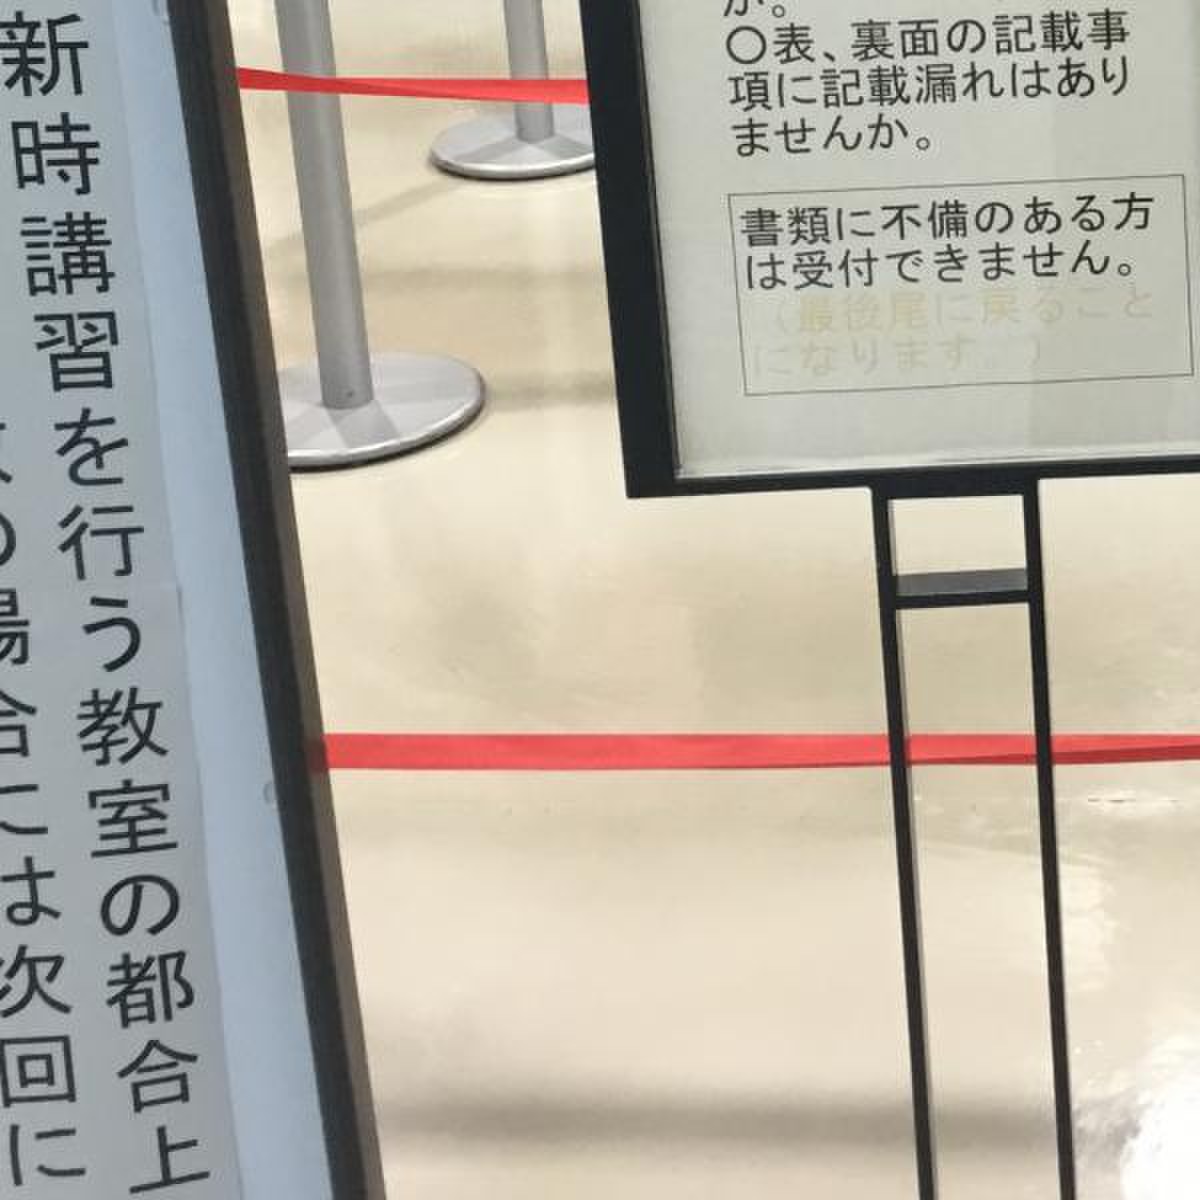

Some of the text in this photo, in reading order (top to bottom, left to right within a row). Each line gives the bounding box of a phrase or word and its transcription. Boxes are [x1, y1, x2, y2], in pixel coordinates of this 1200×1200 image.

[728, 56, 1130, 113] 項に記載漏れはあり
[733, 114, 932, 158] ませんか。
[739, 190, 1155, 248] 書類に不備のある方
[746, 240, 1135, 291] は受付できません。
[0, 421, 87, 1186] には次回に
